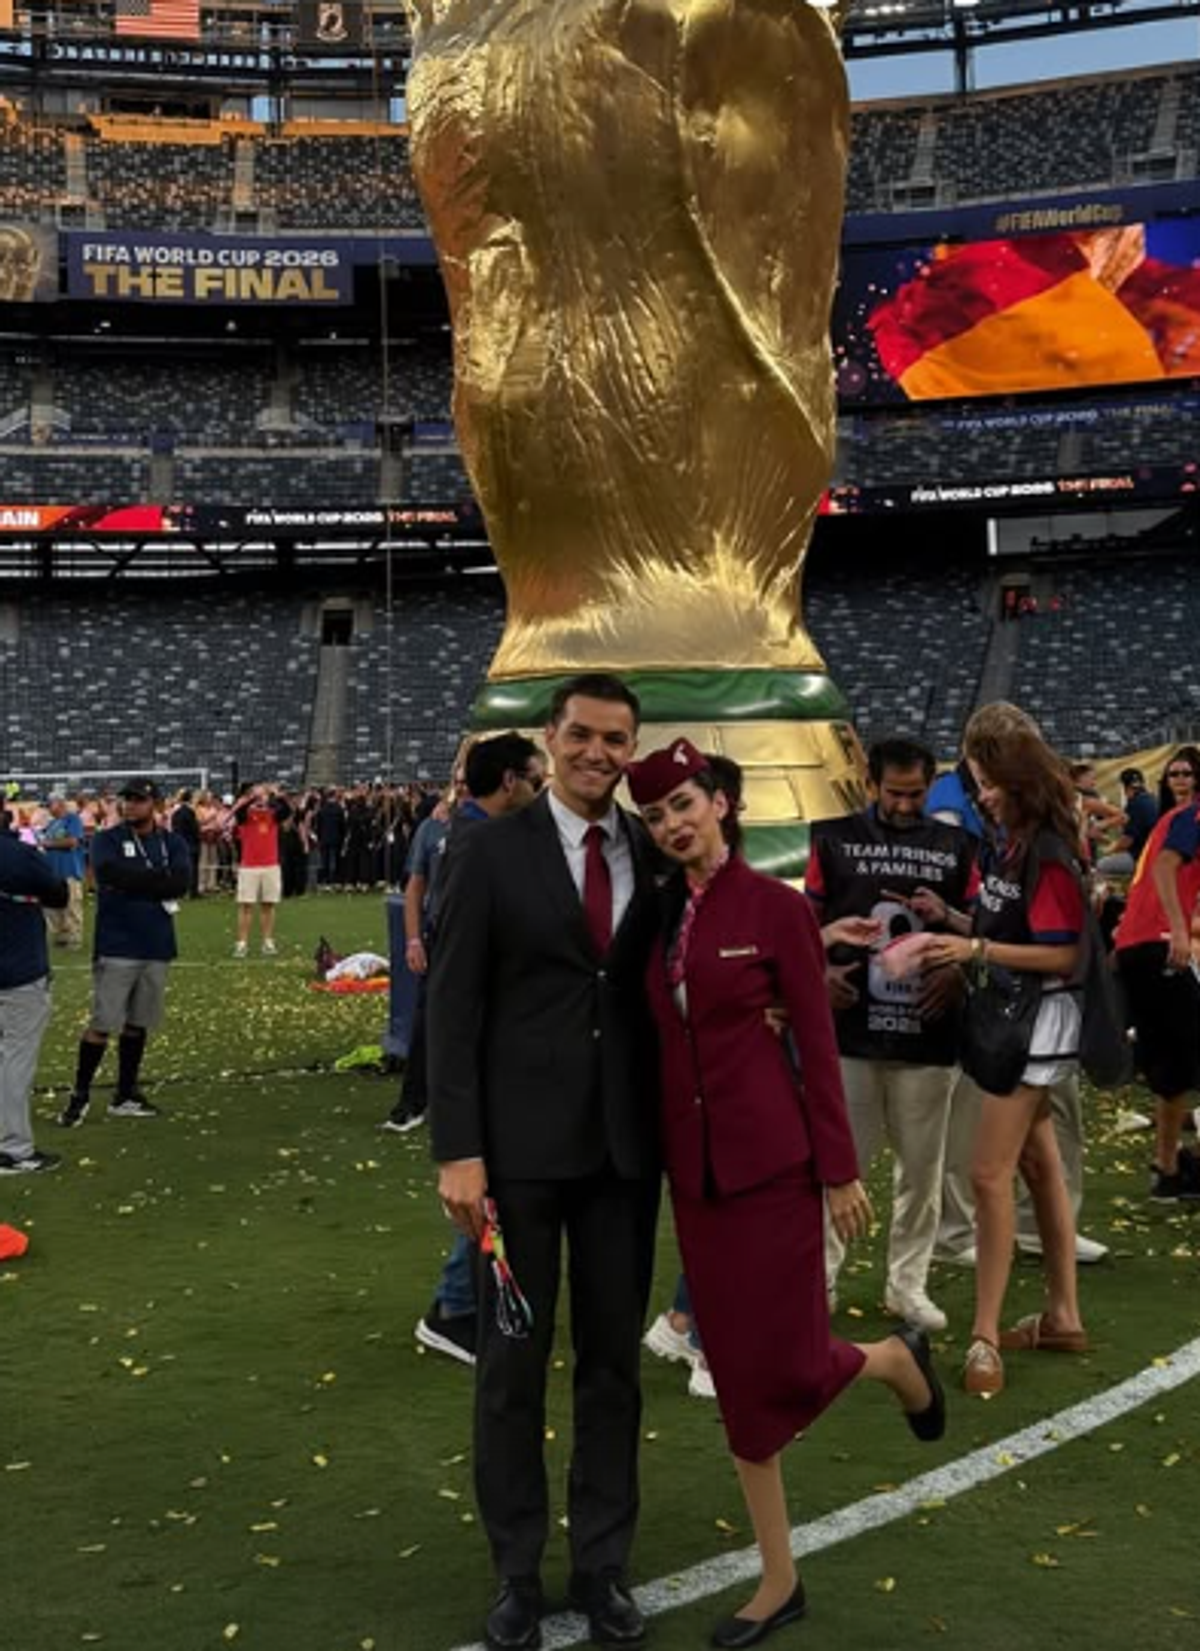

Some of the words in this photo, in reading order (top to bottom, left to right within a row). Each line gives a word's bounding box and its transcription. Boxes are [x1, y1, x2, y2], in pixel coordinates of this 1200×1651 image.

[83, 244, 131, 263] FIFA
[134, 246, 213, 265] WORLD
[216, 249, 261, 266] CUP
[264, 250, 339, 267] 2026
[83, 264, 185, 297] THE
[194, 267, 339, 299] FINAL
[938, 486, 981, 501] WORLD
[983, 485, 1009, 498] CUP
[0, 511, 38, 525] AIN
[274, 511, 315, 524] WORLD
[316, 511, 342, 524] CUP
[842, 843, 890, 858] TEAM
[892, 847, 957, 867] FRIENDS
[856, 862, 868, 875] &
[871, 862, 943, 881] FAMILIES
